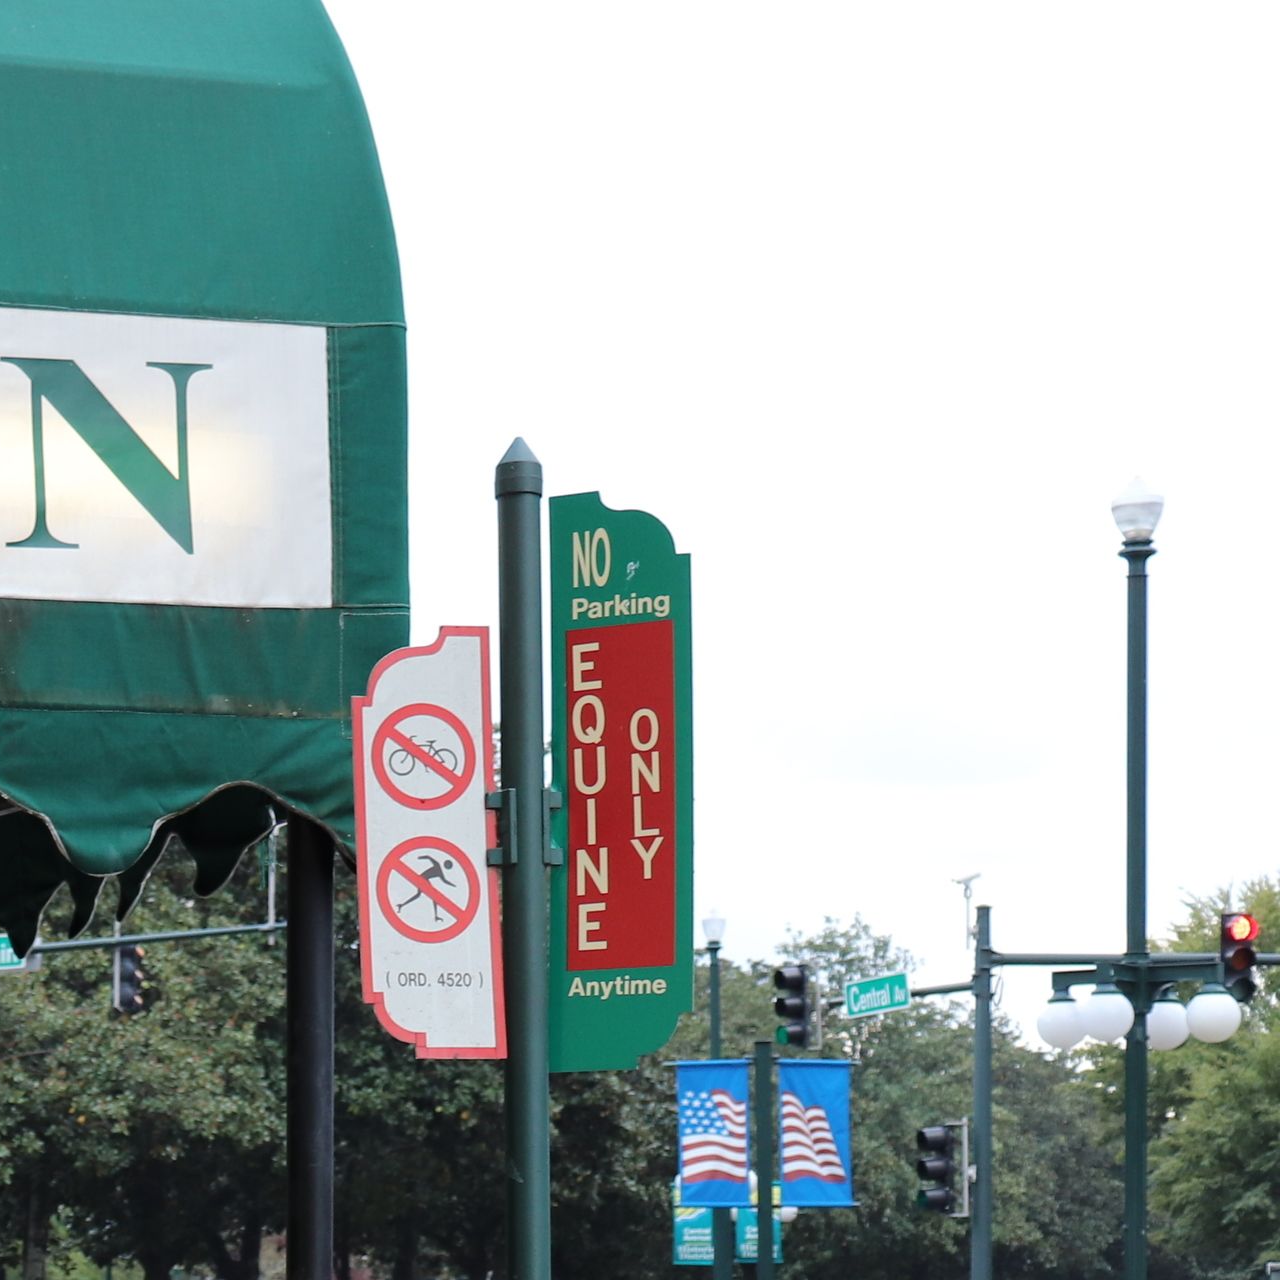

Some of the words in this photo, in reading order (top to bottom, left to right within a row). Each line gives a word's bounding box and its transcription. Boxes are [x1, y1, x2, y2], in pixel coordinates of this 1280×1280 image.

[572, 527, 611, 588] NO
[571, 592, 671, 620] Parking
[571, 641, 609, 951] EQUINE
[629, 708, 665, 880] ONLY
[397, 972, 431, 988] ORD.
[437, 972, 472, 988] 4520
[567, 974, 668, 1000] Anytime
[849, 983, 891, 1013] Central
